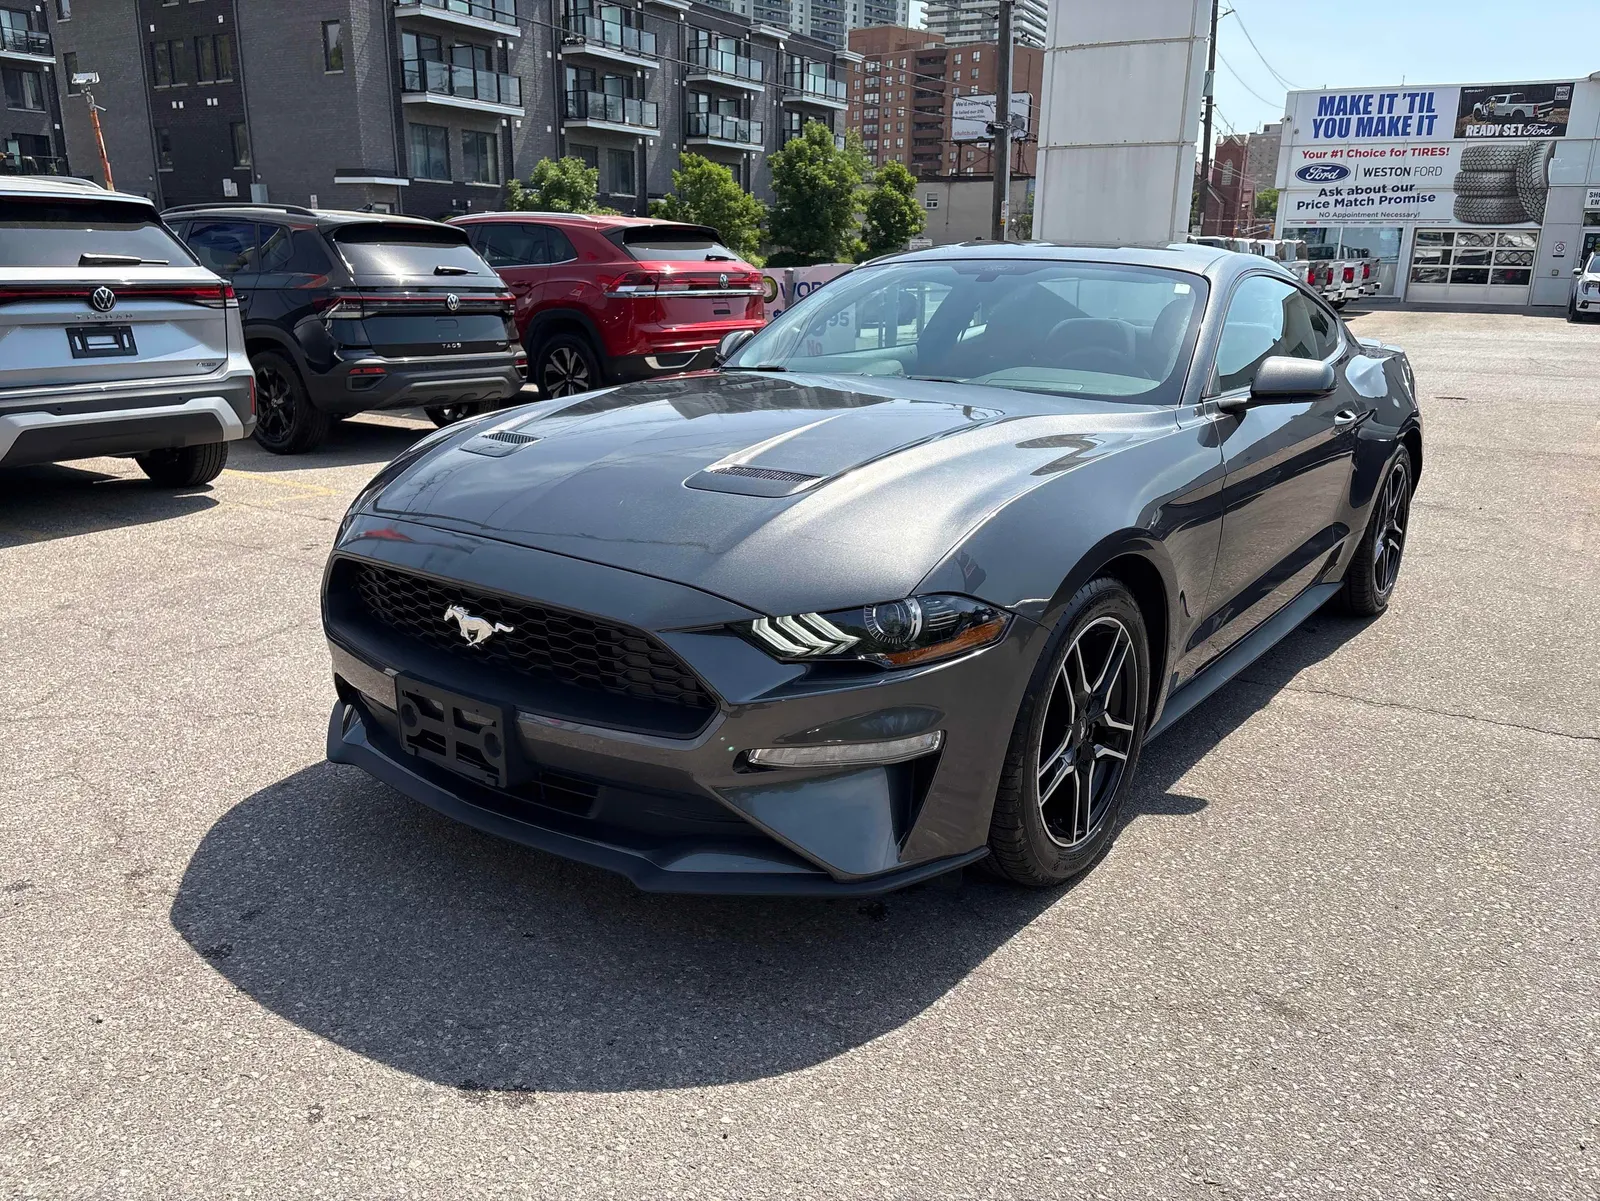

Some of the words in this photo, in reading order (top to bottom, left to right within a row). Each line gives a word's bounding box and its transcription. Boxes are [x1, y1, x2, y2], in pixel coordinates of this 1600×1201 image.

[1317, 94, 1374, 116] MAKE
[1377, 93, 1398, 115] IT
[1402, 92, 1435, 114] 'TIL
[1312, 117, 1352, 139] YOU
[1355, 115, 1413, 138] MAKE
[1416, 114, 1438, 136] IT
[1465, 124, 1502, 137] READY
[1502, 124, 1524, 136] SET
[1522, 123, 1555, 136] Ford
[1302, 150, 1328, 160] Your
[1330, 149, 1344, 159] #1
[1346, 148, 1387, 158] Choice
[1389, 147, 1408, 157] for
[1410, 147, 1450, 157] TIRES!
[1305, 165, 1339, 181] Ford
[1363, 166, 1412, 178] WESTON
[1413, 166, 1443, 177] FORD
[1318, 187, 1344, 198] Ask
[1347, 184, 1387, 196] about
[1391, 183, 1416, 193] our
[1296, 200, 1331, 211] Price
[1333, 197, 1375, 208] Match
[1378, 194, 1437, 205] Promise
[1318, 211, 1331, 219] NO
[1332, 211, 1379, 219] Appointment
[1380, 211, 1421, 219] Necessary!
